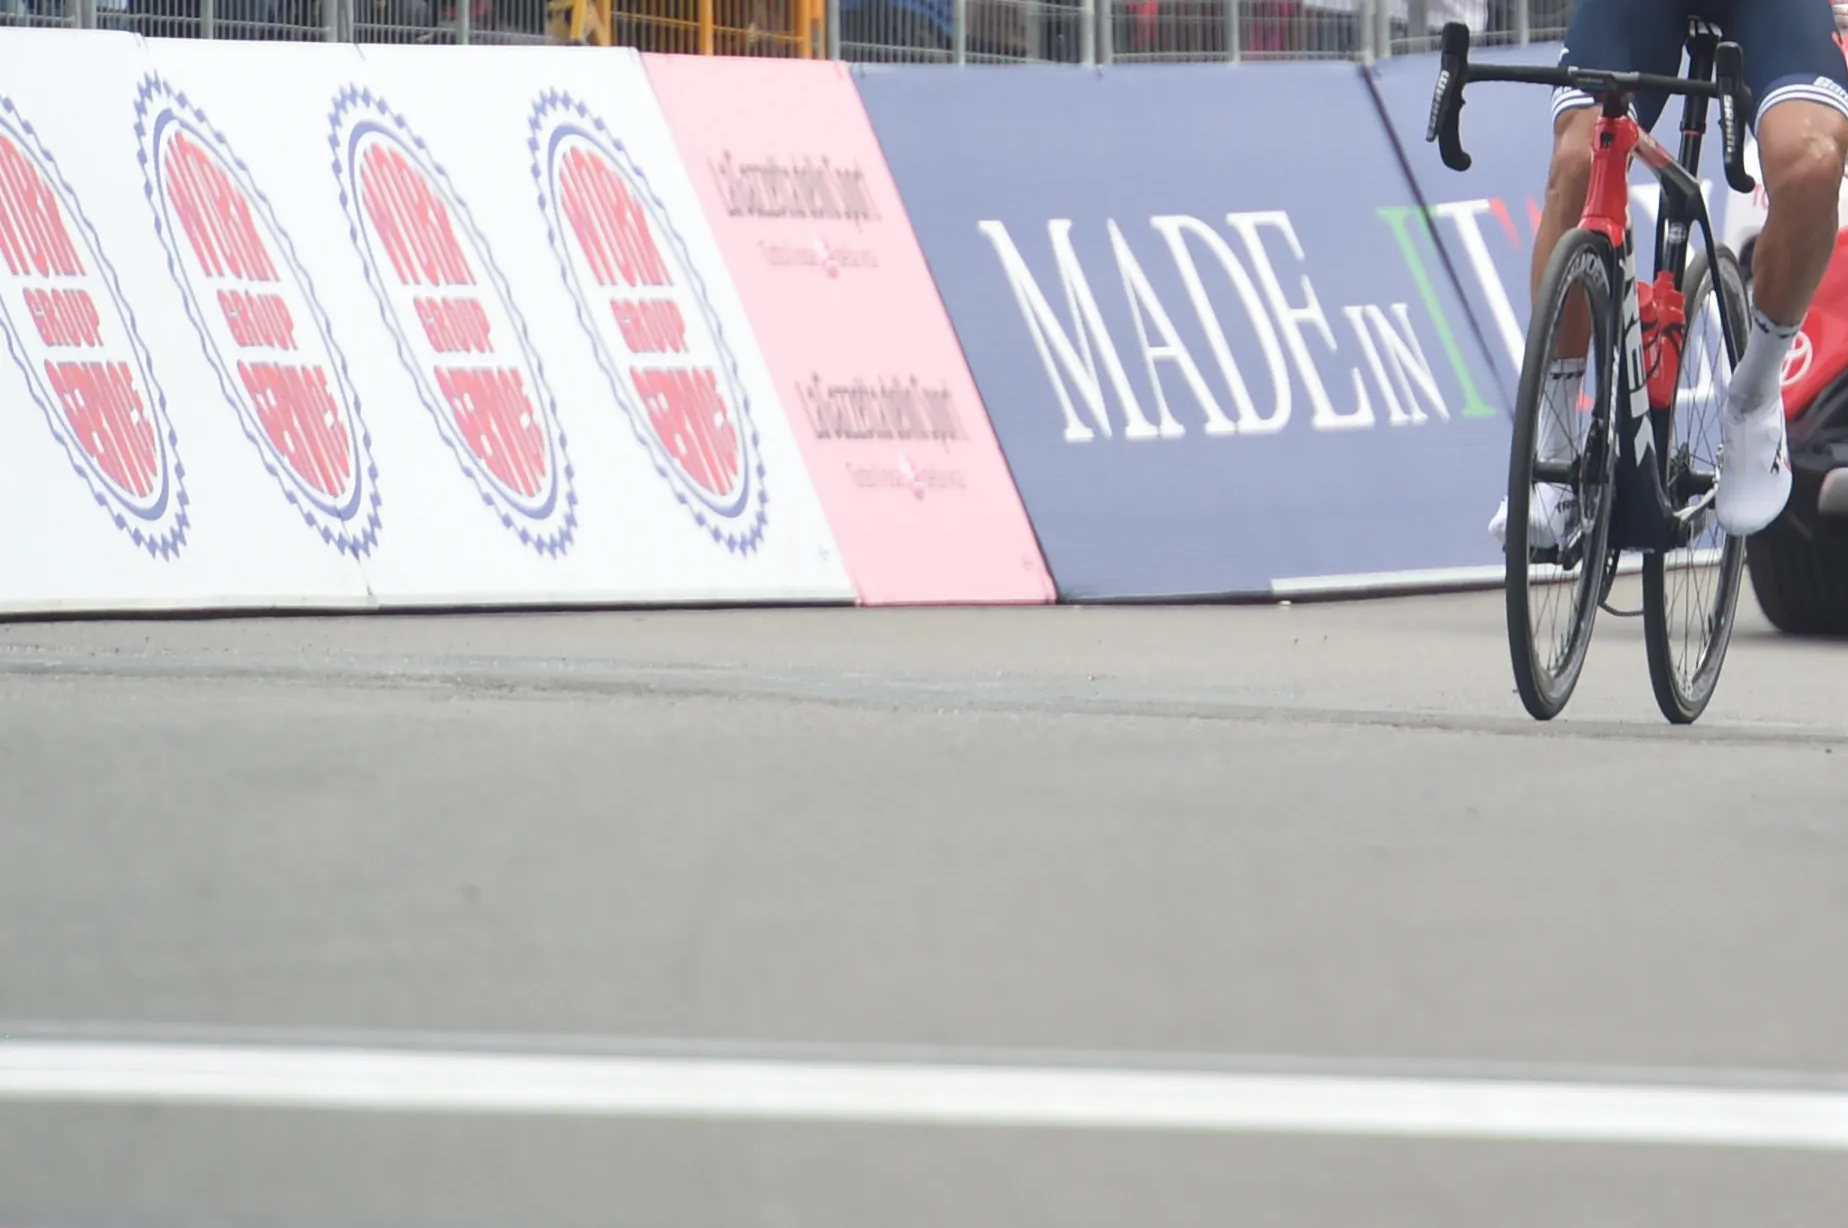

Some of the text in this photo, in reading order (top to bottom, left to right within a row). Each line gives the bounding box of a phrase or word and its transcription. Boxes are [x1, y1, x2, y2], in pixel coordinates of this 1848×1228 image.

[22, 288, 104, 347] GROUP
[216, 290, 295, 351] GROUP
[412, 298, 493, 354] GROUP
[609, 300, 689, 355] GROUP
[978, 210, 1377, 443] MADE
[1342, 301, 1450, 429] IN
